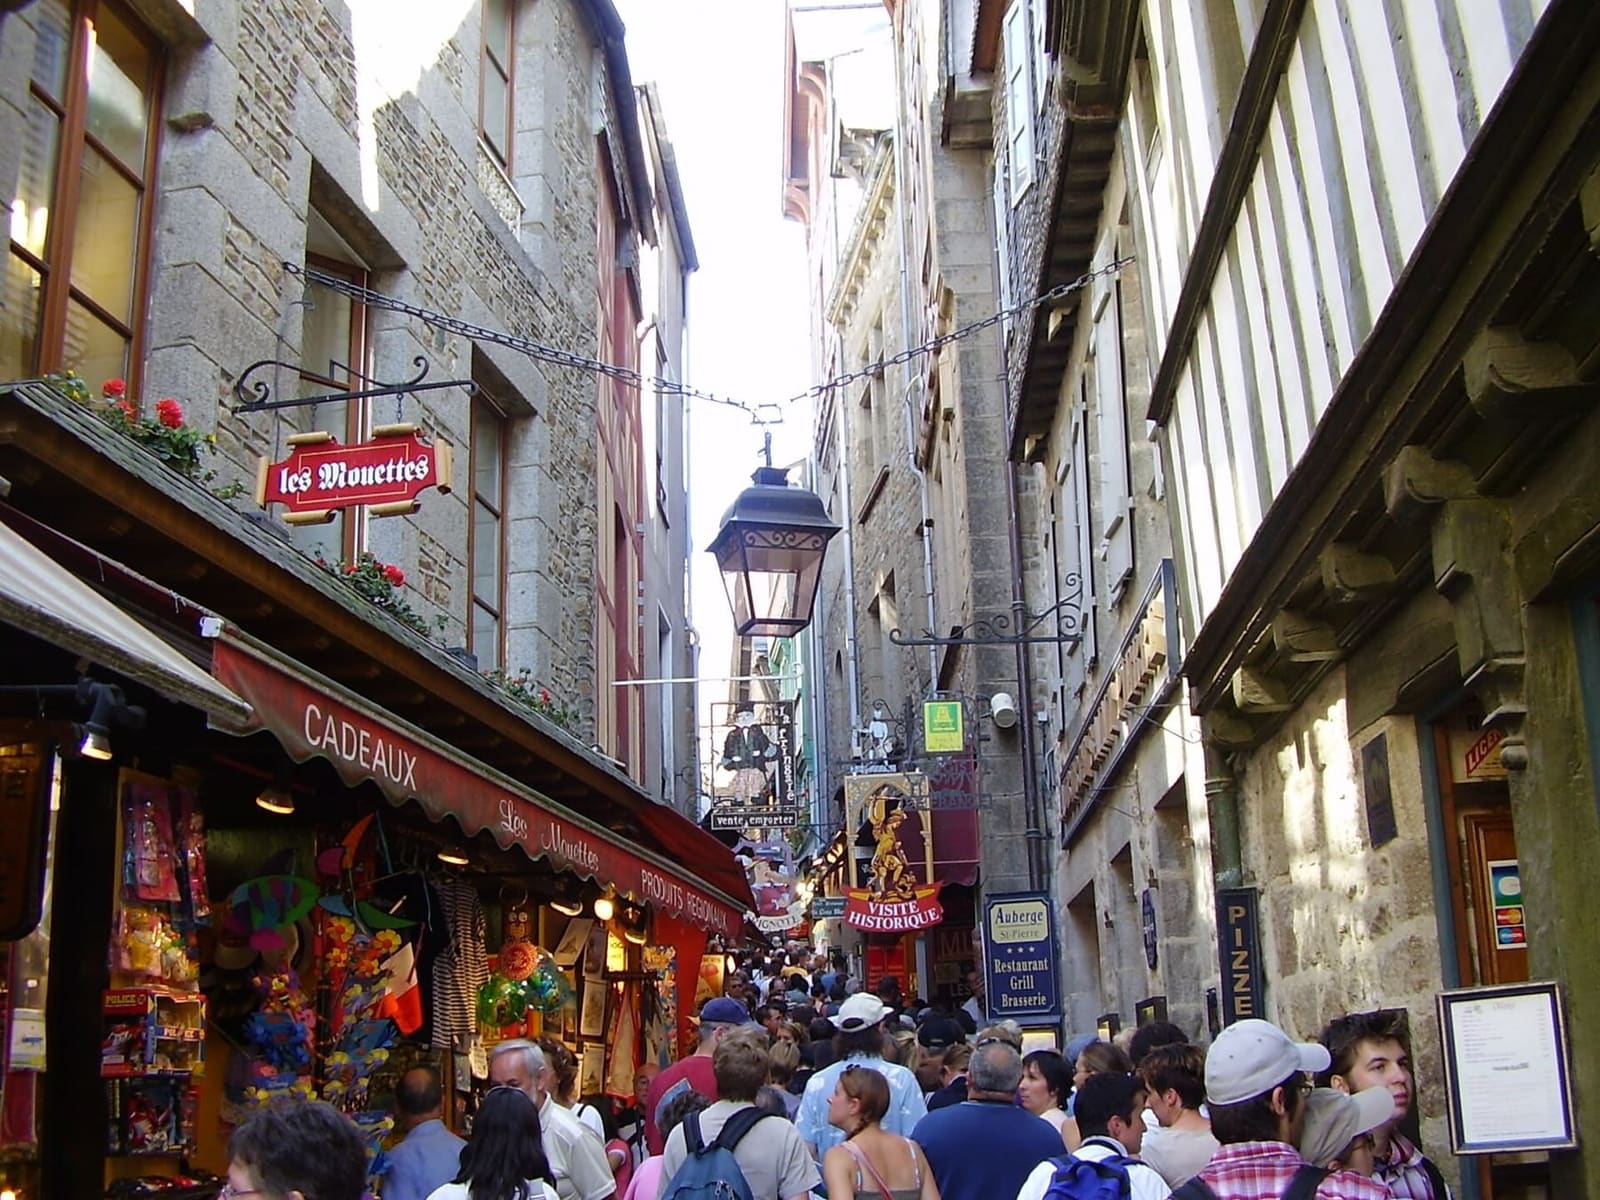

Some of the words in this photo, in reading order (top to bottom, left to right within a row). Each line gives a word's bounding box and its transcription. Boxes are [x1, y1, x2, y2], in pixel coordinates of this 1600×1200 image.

[279, 466, 312, 494] les
[317, 454, 430, 491] Mouettes
[304, 703, 417, 792] CADEAUX
[749, 815, 794, 826] emporter
[499, 799, 528, 840] Les
[540, 821, 599, 872] Mouettes
[641, 868, 684, 910] PRODUITS
[868, 900, 920, 916] VISITE
[995, 906, 1044, 926] Auberge
[848, 907, 940, 930] HISTORIQUE
[994, 957, 1049, 974] Restaurant
[1009, 975, 1035, 991] Grill
[105, 994, 137, 1004] POLICE
[1001, 991, 1047, 1008] Brasserie
[163, 1028, 195, 1038] POLCE
